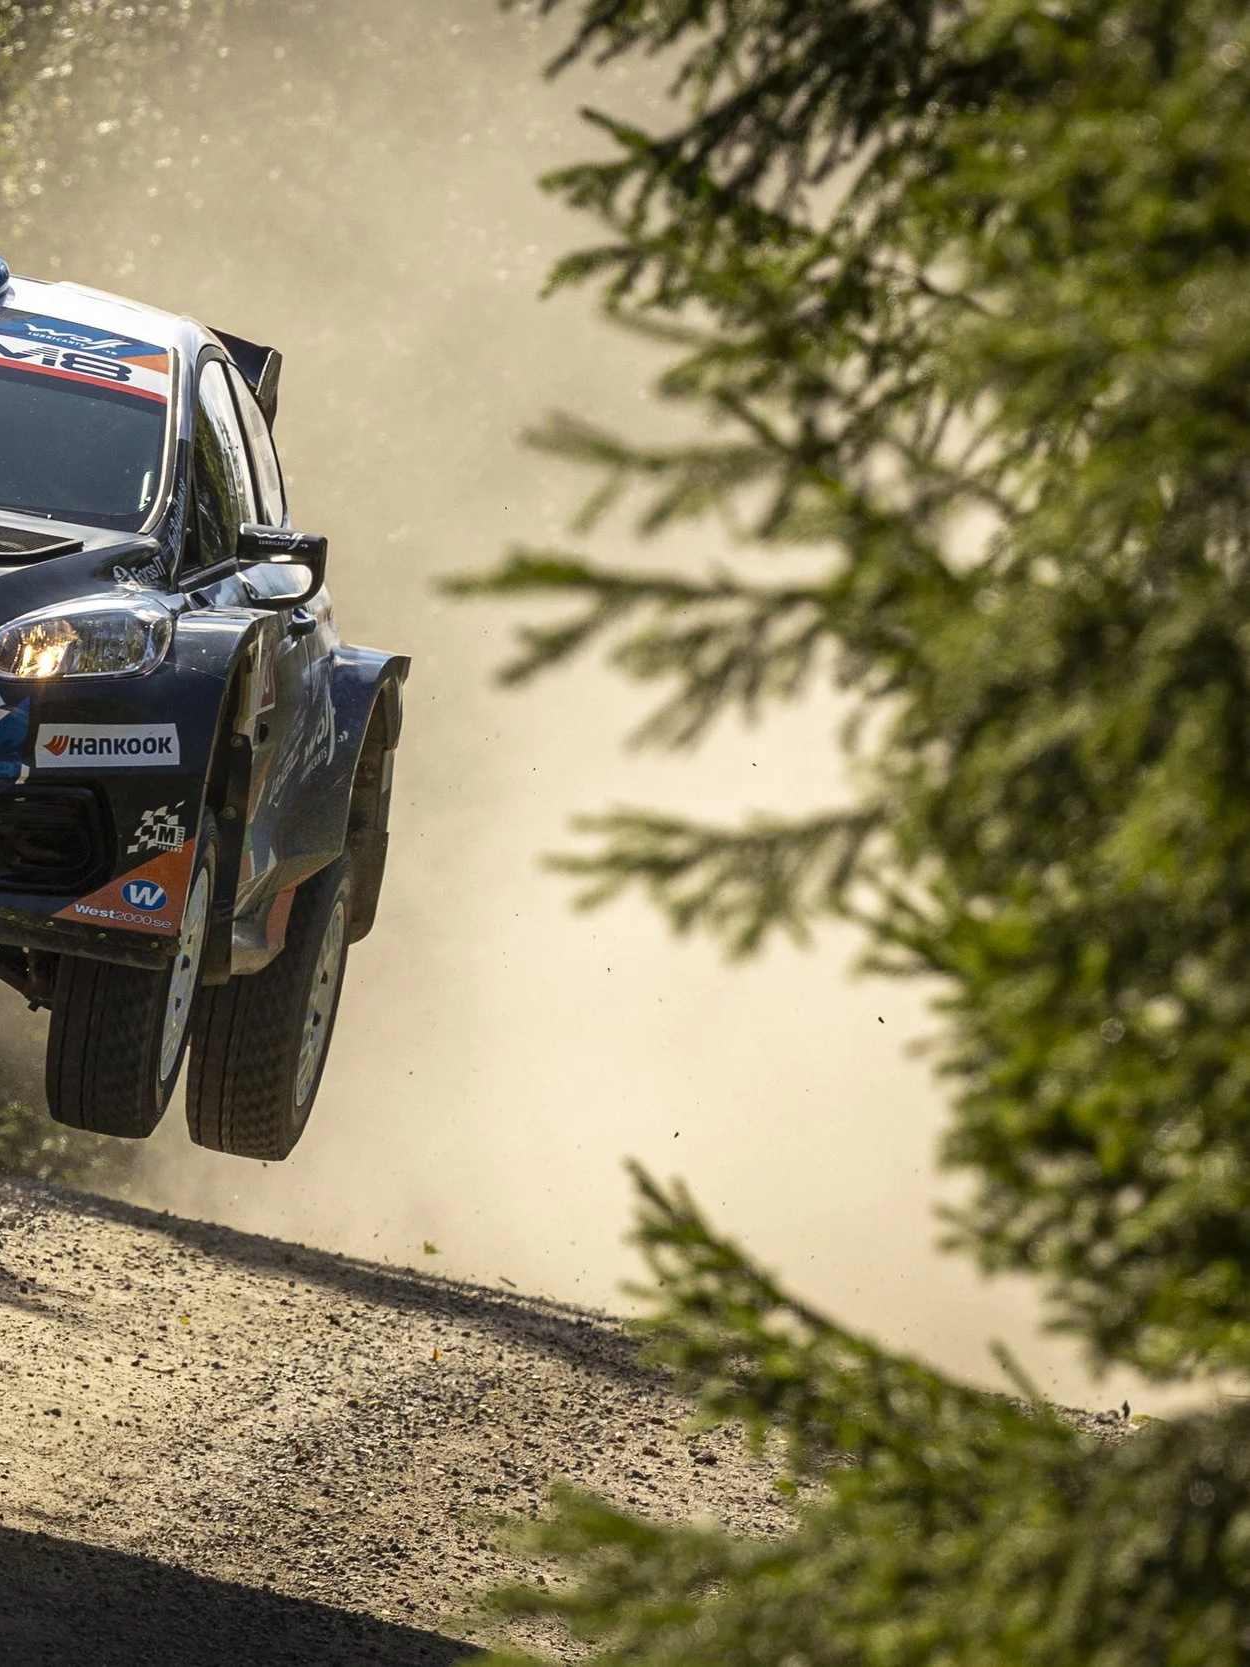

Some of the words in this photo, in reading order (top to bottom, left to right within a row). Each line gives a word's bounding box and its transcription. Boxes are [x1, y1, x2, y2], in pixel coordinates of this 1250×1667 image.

[27, 331, 86, 347] LUBRICANTS
[129, 884, 165, 906] W
[74, 903, 172, 929] West2000.se
